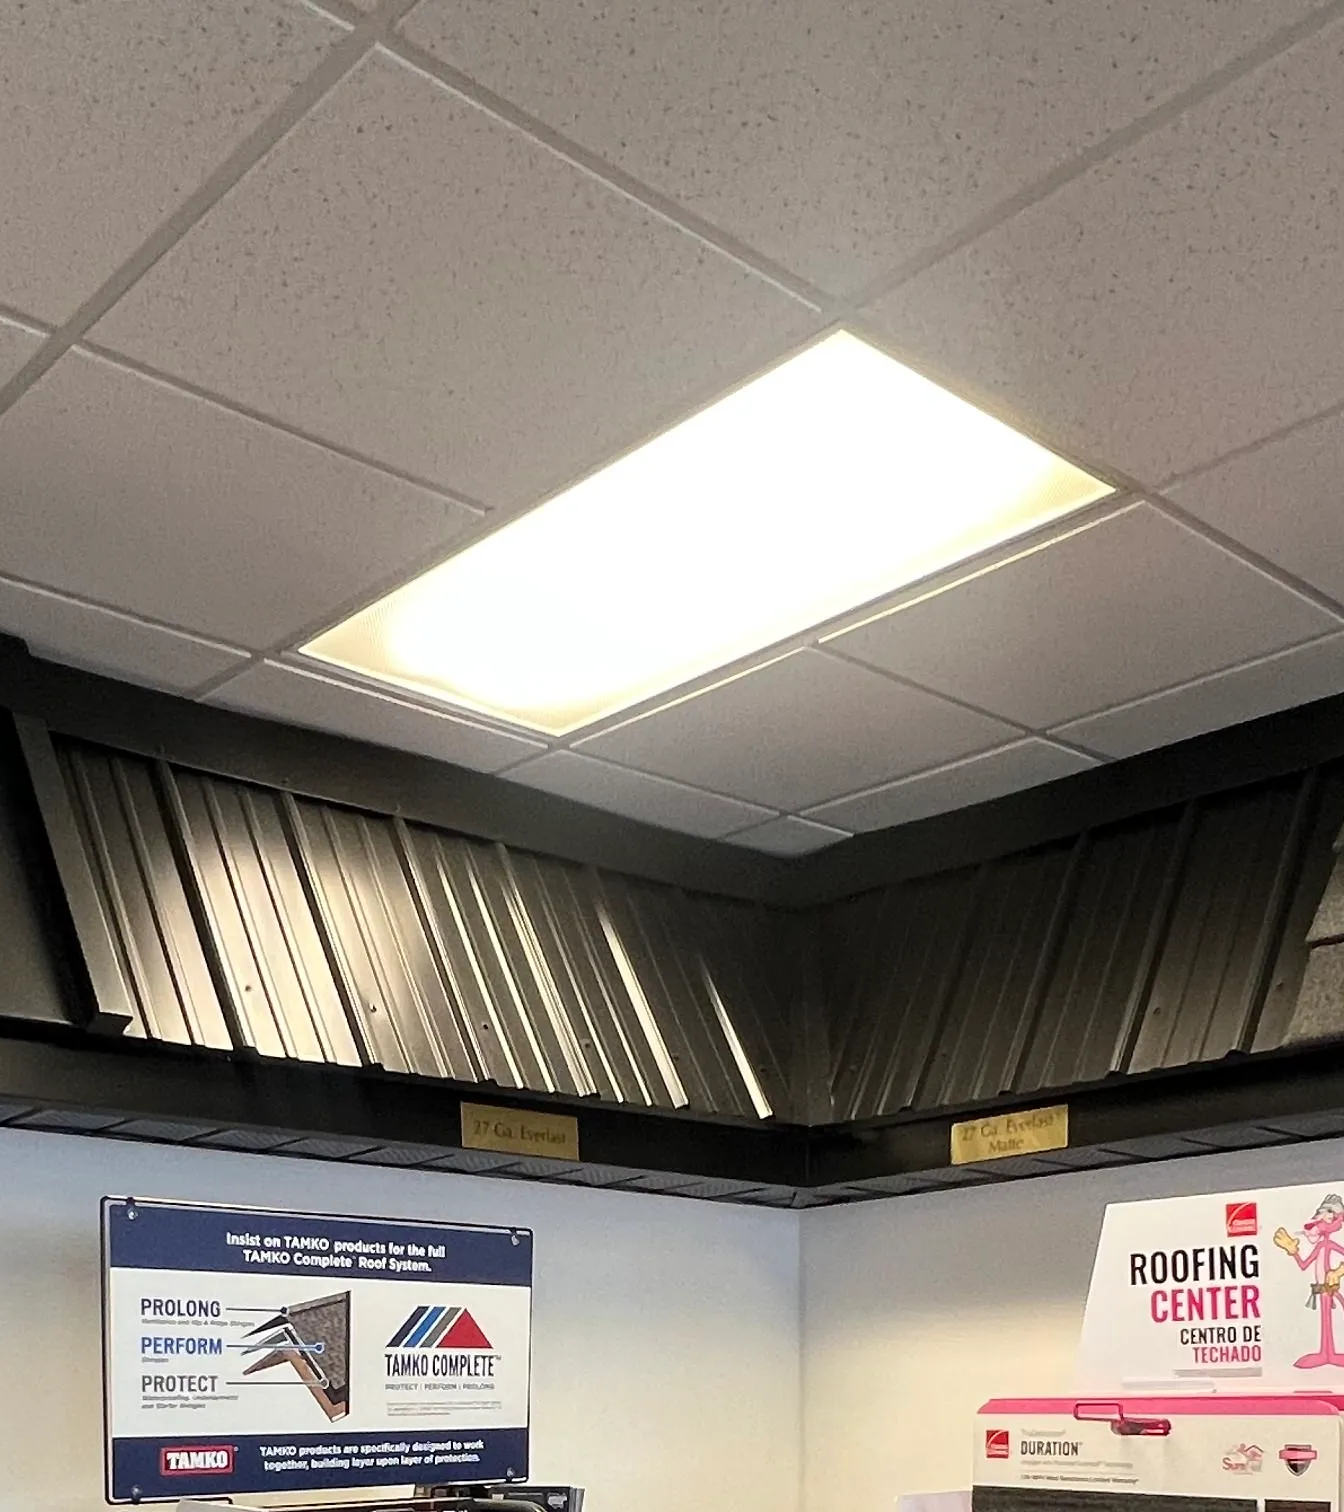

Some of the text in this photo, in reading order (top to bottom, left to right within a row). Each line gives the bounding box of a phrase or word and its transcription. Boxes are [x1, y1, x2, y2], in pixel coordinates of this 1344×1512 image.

[988, 1136, 1025, 1154] Matte
[226, 1231, 446, 1258] Insist on TAMKO products for the full
[242, 1249, 291, 1265] TAMKO
[358, 1256, 387, 1270] Roof
[388, 1257, 432, 1273] System.
[1129, 1244, 1260, 1286] ROOFING
[140, 1298, 221, 1318] PROLONG
[1150, 1284, 1261, 1323] CENTER
[1180, 1325, 1262, 1345] CENTRO DE
[140, 1336, 223, 1355] PERFORM
[1192, 1344, 1262, 1364] TECHADO
[384, 1353, 429, 1377] TAMKO
[141, 1375, 219, 1393] PROTECT
[259, 1445, 297, 1457] TAMKO
[298, 1444, 342, 1458] products
[452, 1440, 463, 1451] to
[463, 1439, 484, 1450] work
[1020, 1440, 1080, 1456] DURATION
[166, 1450, 229, 1470] TAMKO
[375, 1457, 400, 1467] upon
[423, 1453, 434, 1464] of
